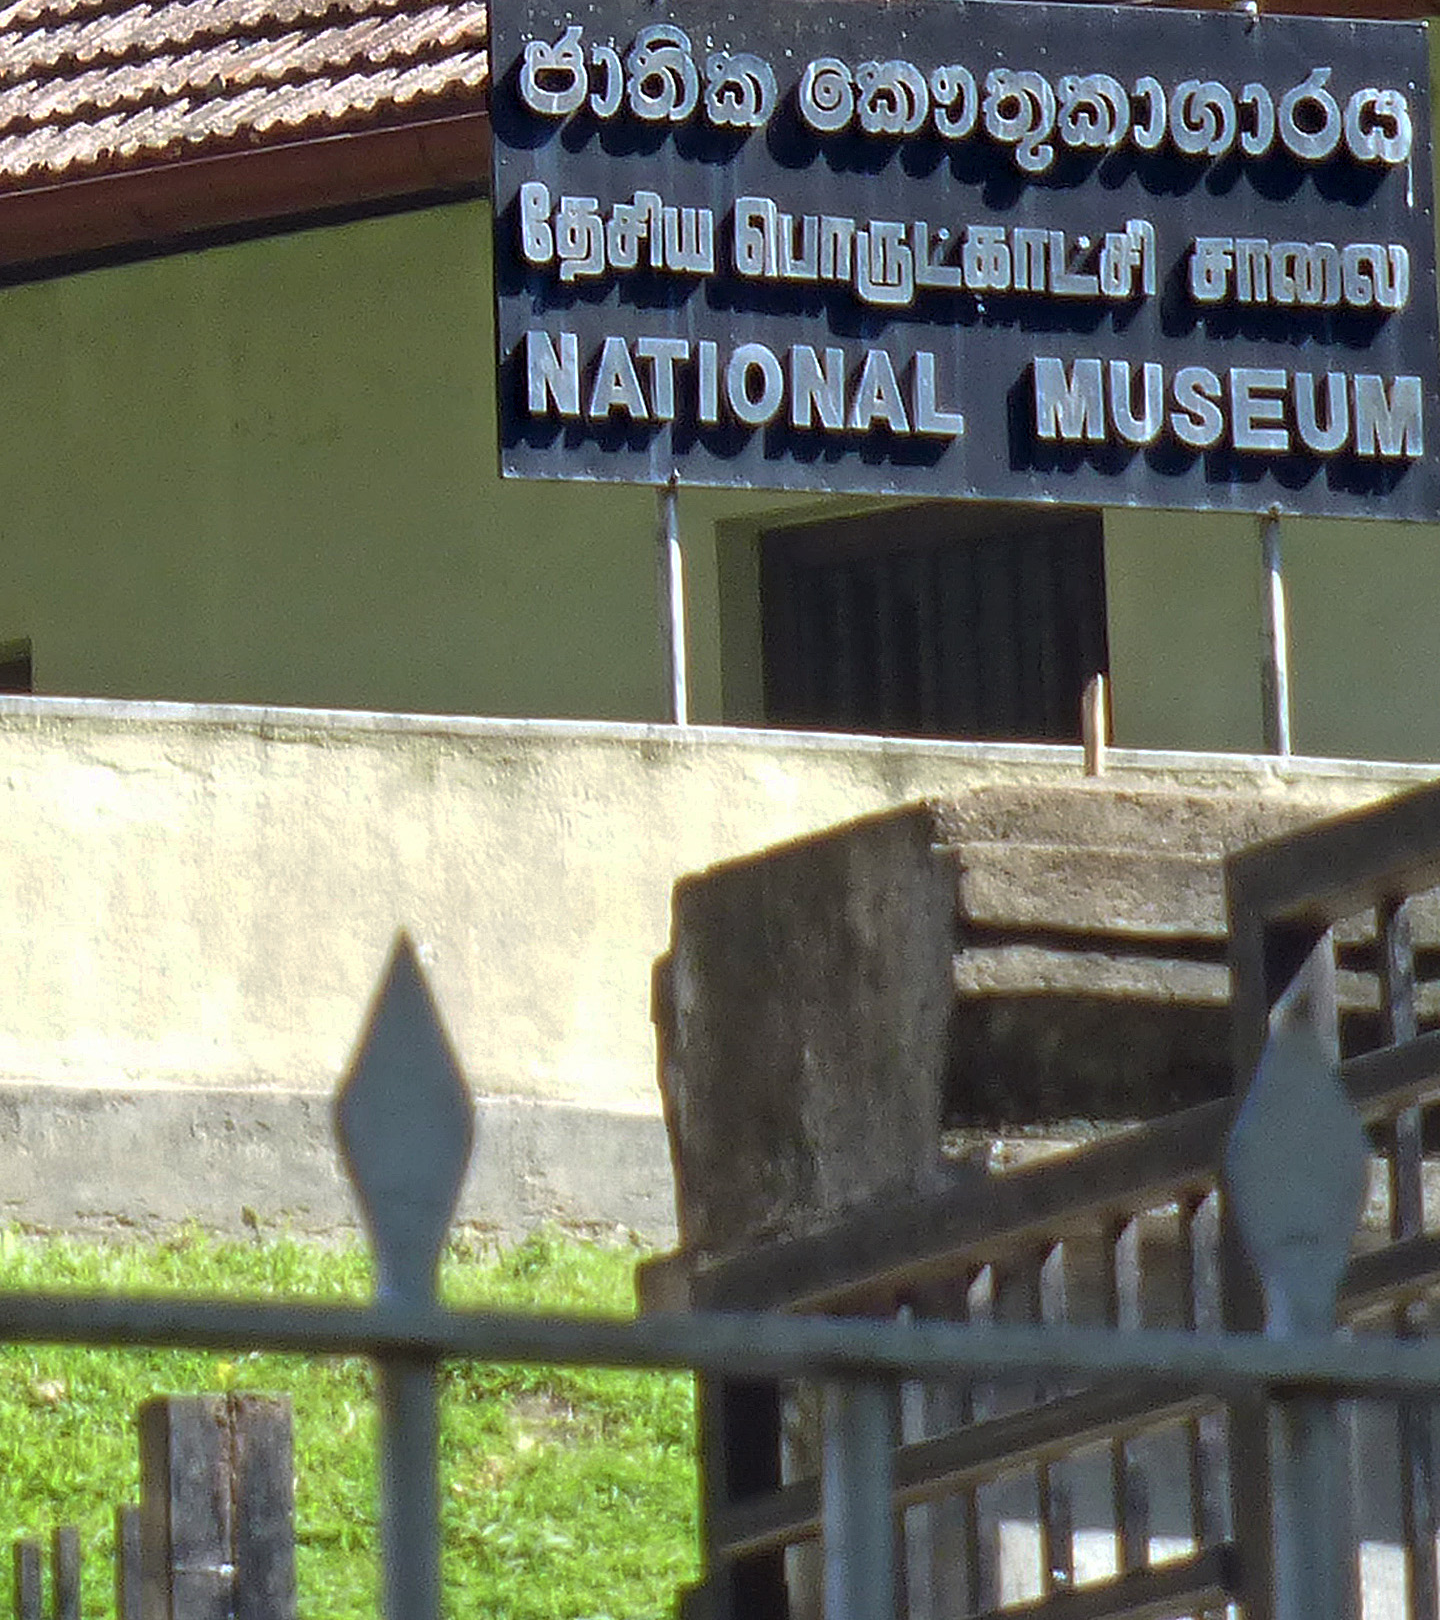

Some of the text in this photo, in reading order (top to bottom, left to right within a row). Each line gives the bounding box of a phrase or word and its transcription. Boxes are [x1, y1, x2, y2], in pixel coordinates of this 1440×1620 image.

[519, 24, 1413, 173] ජාතික කෞතුකාගාරය
[520, 181, 716, 281] தேசிய
[734, 196, 1157, 305] பொருட்காட்சி
[524, 330, 1425, 459] NATIONAL MUSEUM
